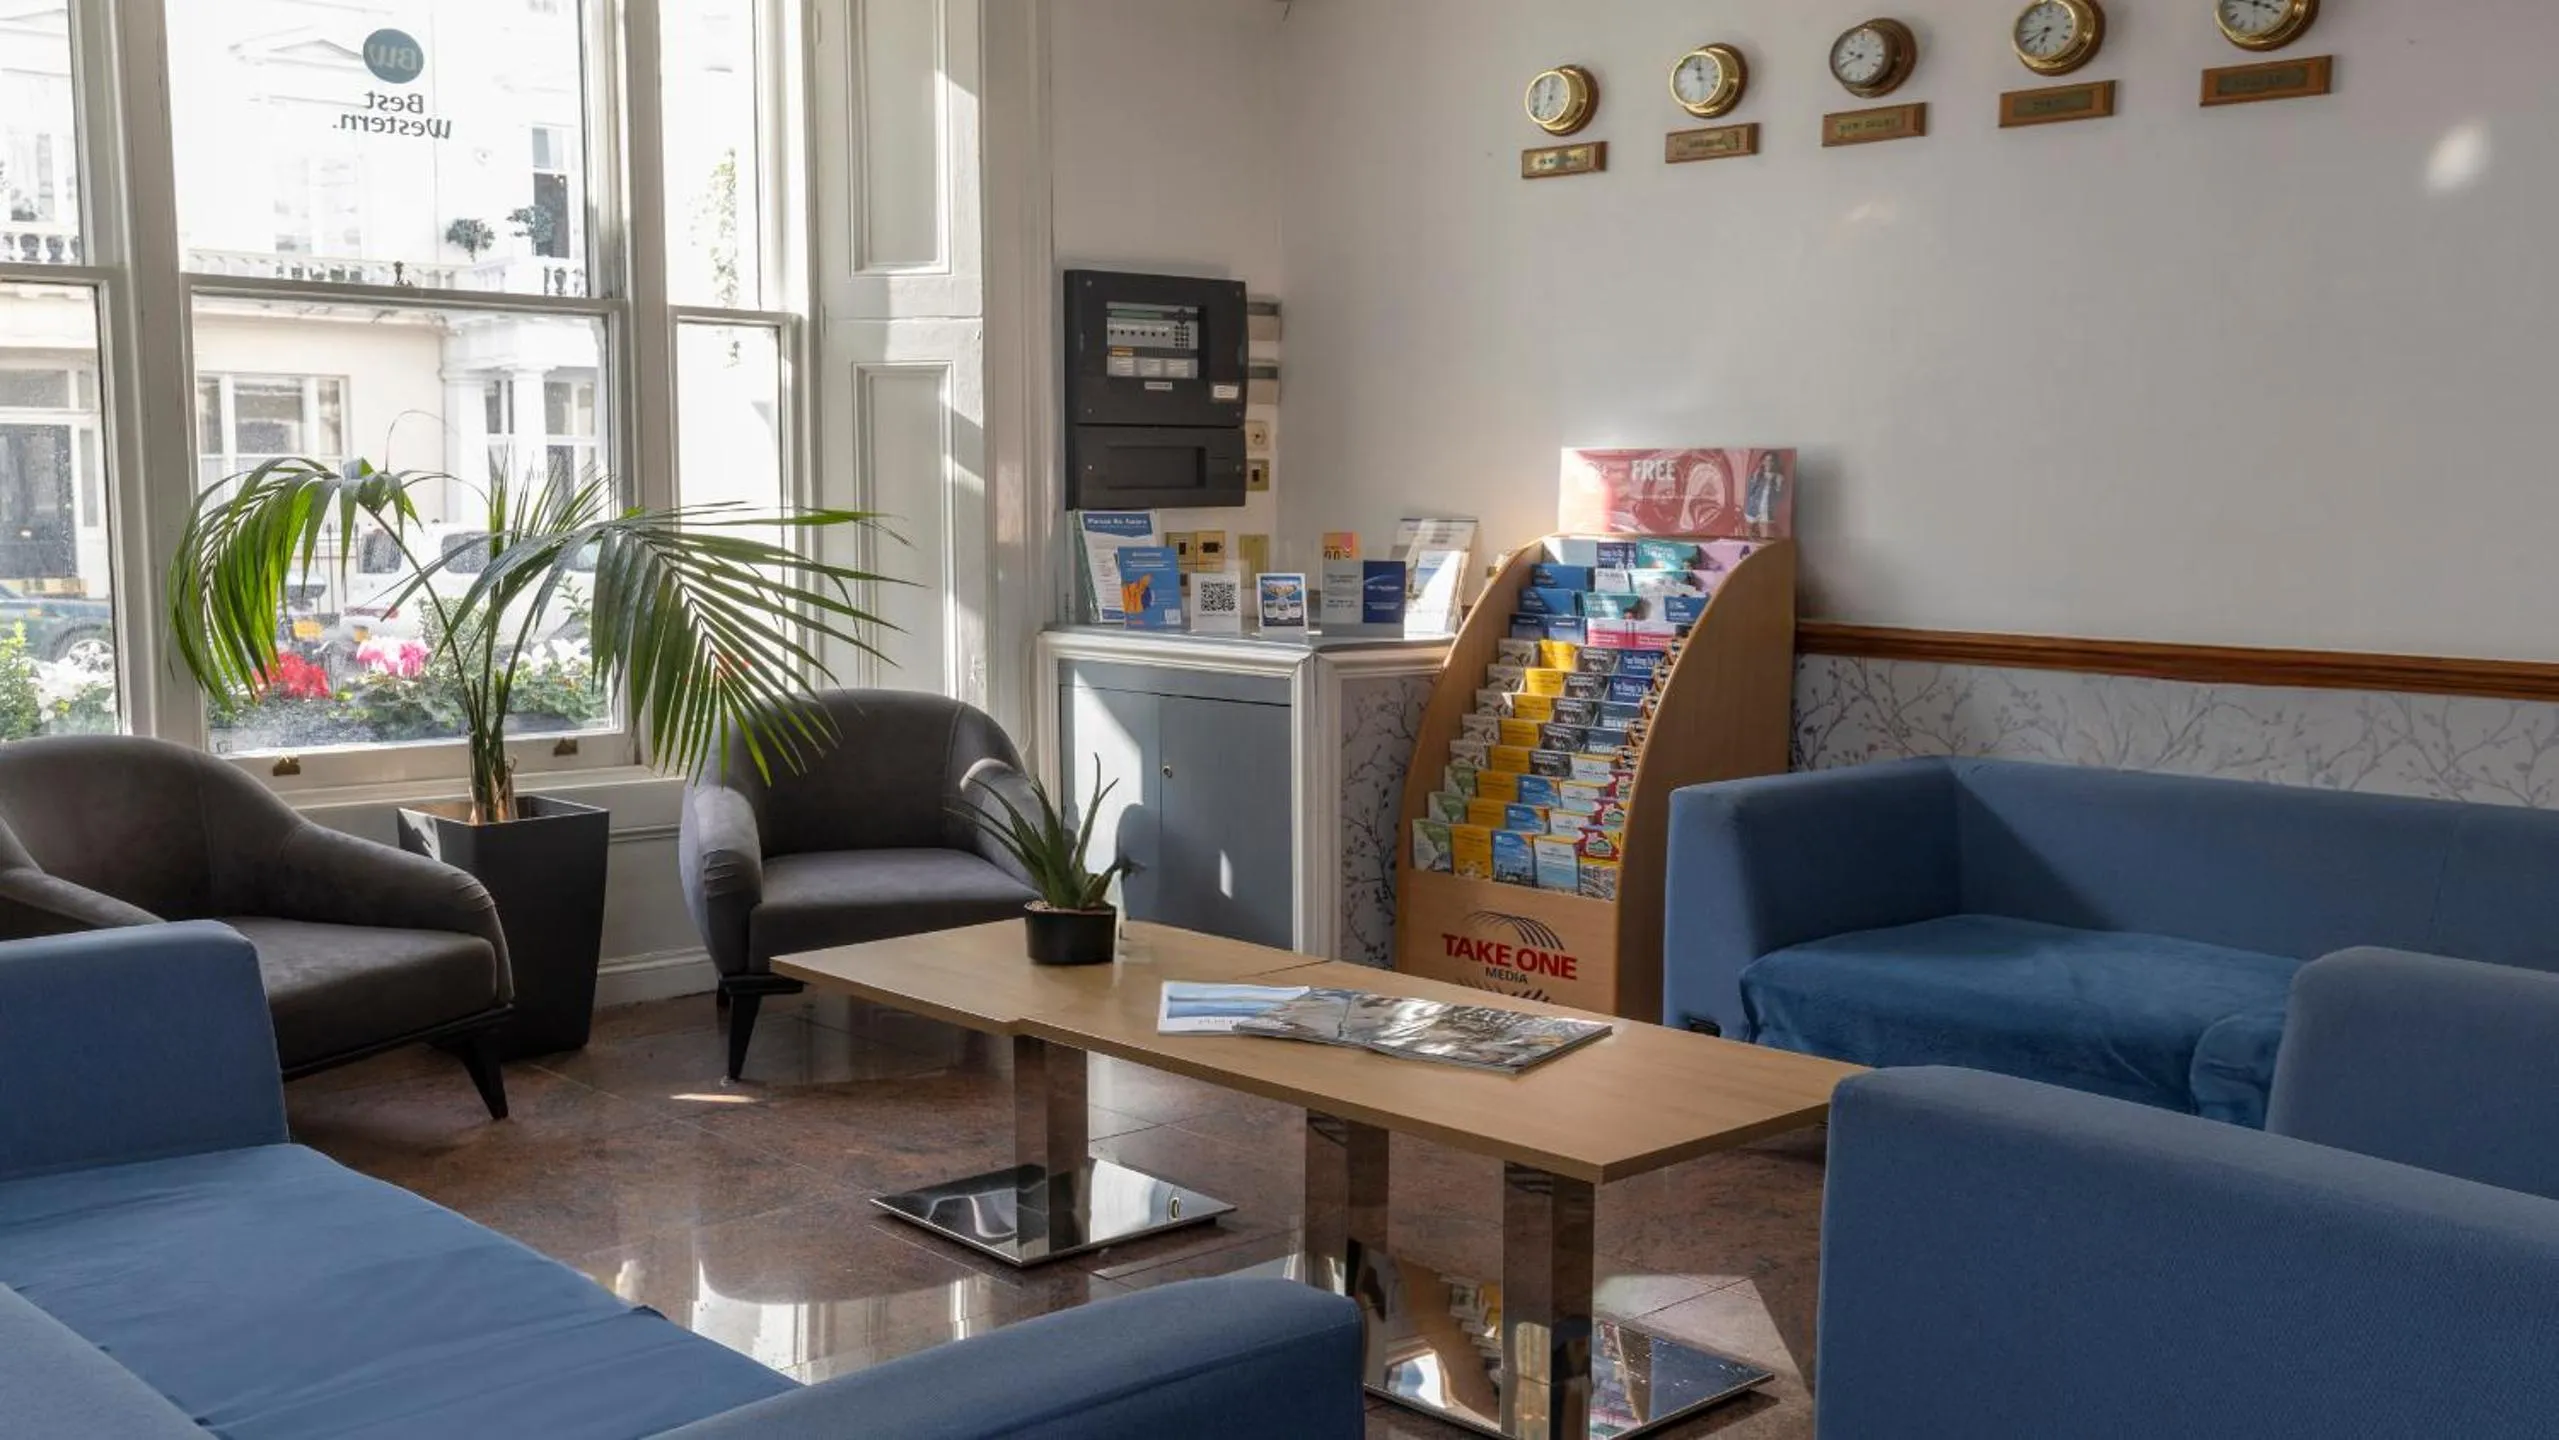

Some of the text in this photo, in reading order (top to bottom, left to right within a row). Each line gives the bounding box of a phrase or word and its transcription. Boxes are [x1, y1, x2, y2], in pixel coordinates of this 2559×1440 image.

[1631, 459, 1676, 481] FREE
[1441, 933, 1578, 981] TAKE ONE
[1485, 966, 1528, 985] MEDIA
